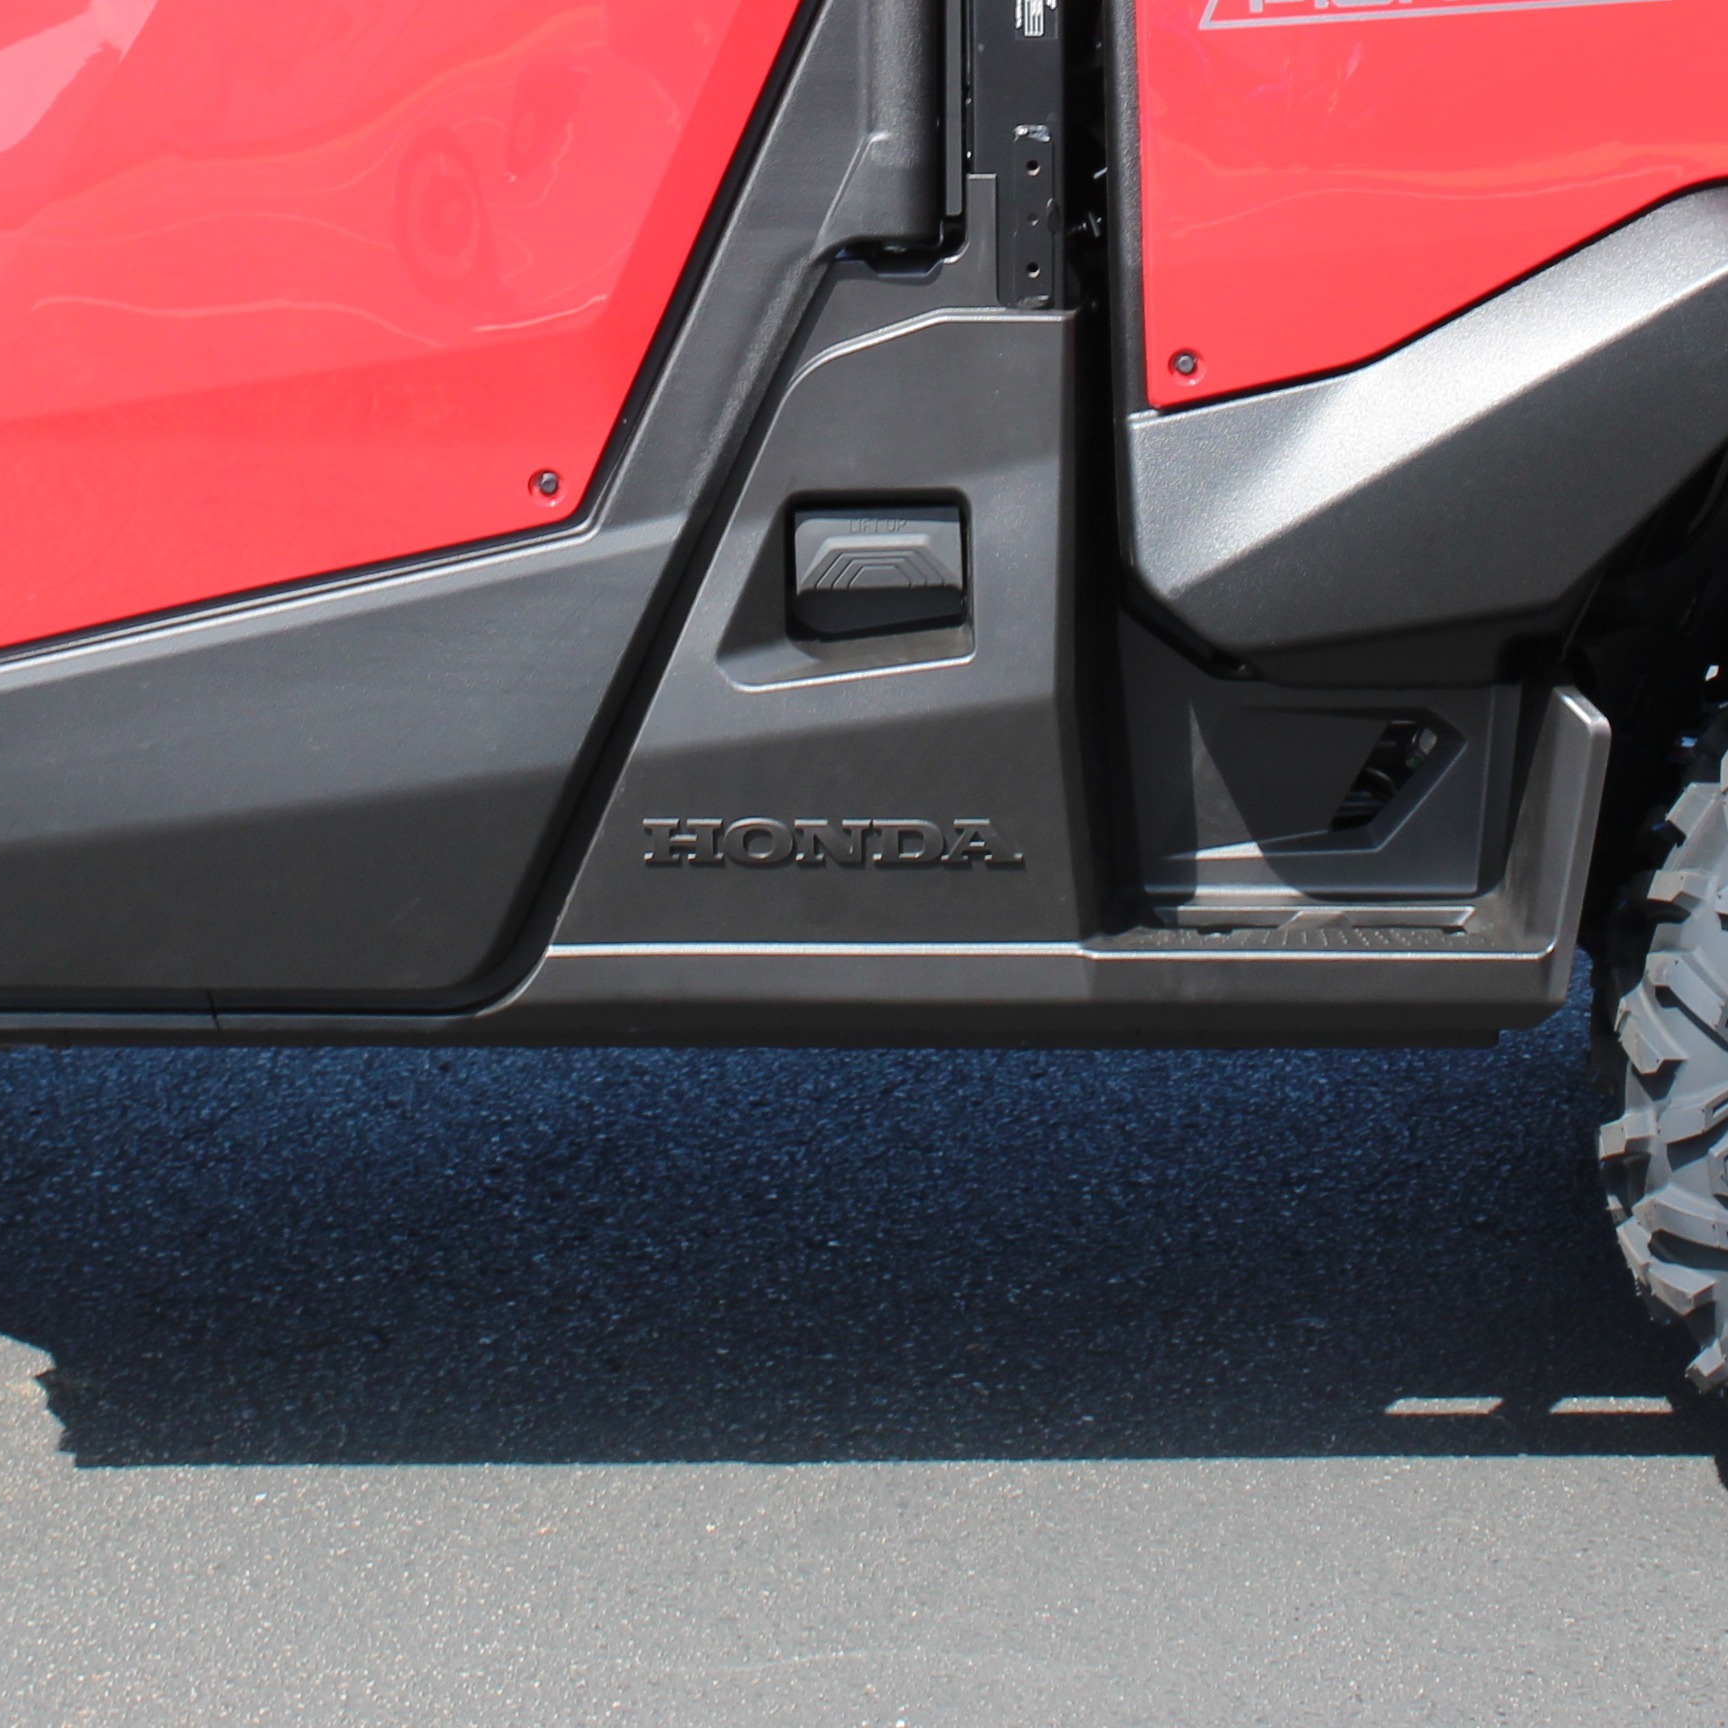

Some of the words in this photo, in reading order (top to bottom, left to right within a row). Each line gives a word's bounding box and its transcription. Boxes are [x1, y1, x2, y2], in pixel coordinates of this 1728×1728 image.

[848, 518, 879, 535] LIFT
[887, 518, 907, 533] UP
[642, 816, 1025, 865] HONDA
